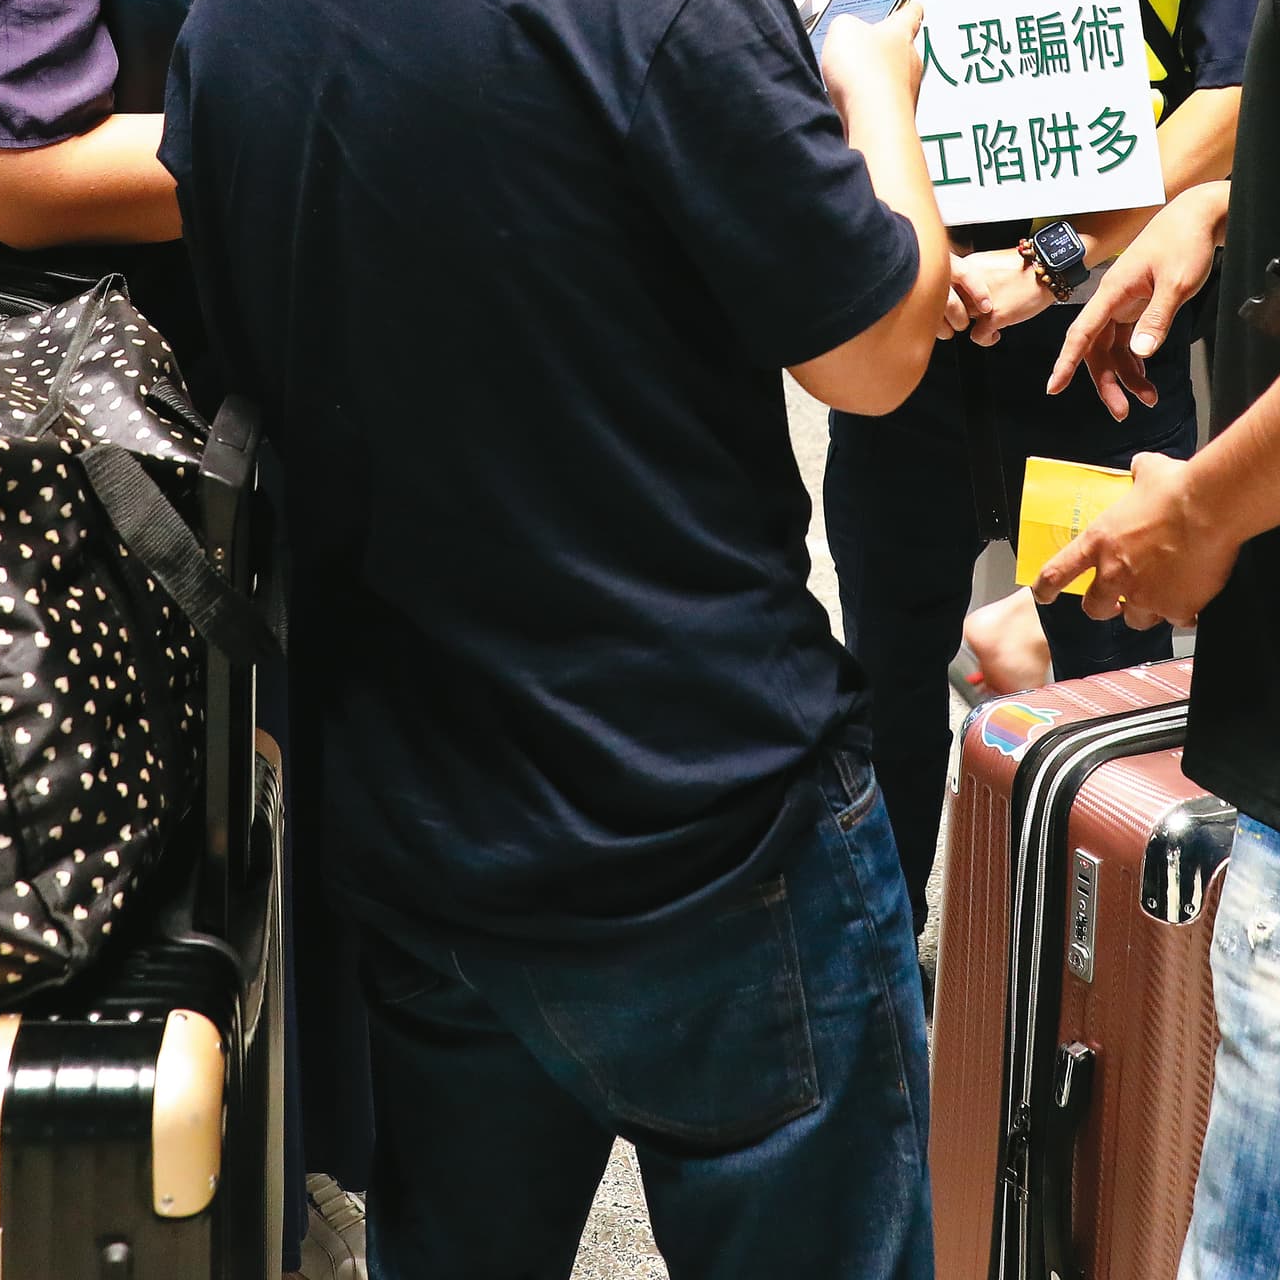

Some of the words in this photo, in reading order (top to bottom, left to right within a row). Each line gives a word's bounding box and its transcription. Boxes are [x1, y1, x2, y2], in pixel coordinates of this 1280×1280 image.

[920, 4, 1125, 86] 人恐騙術
[920, 107, 1138, 186] 工陷阱多
